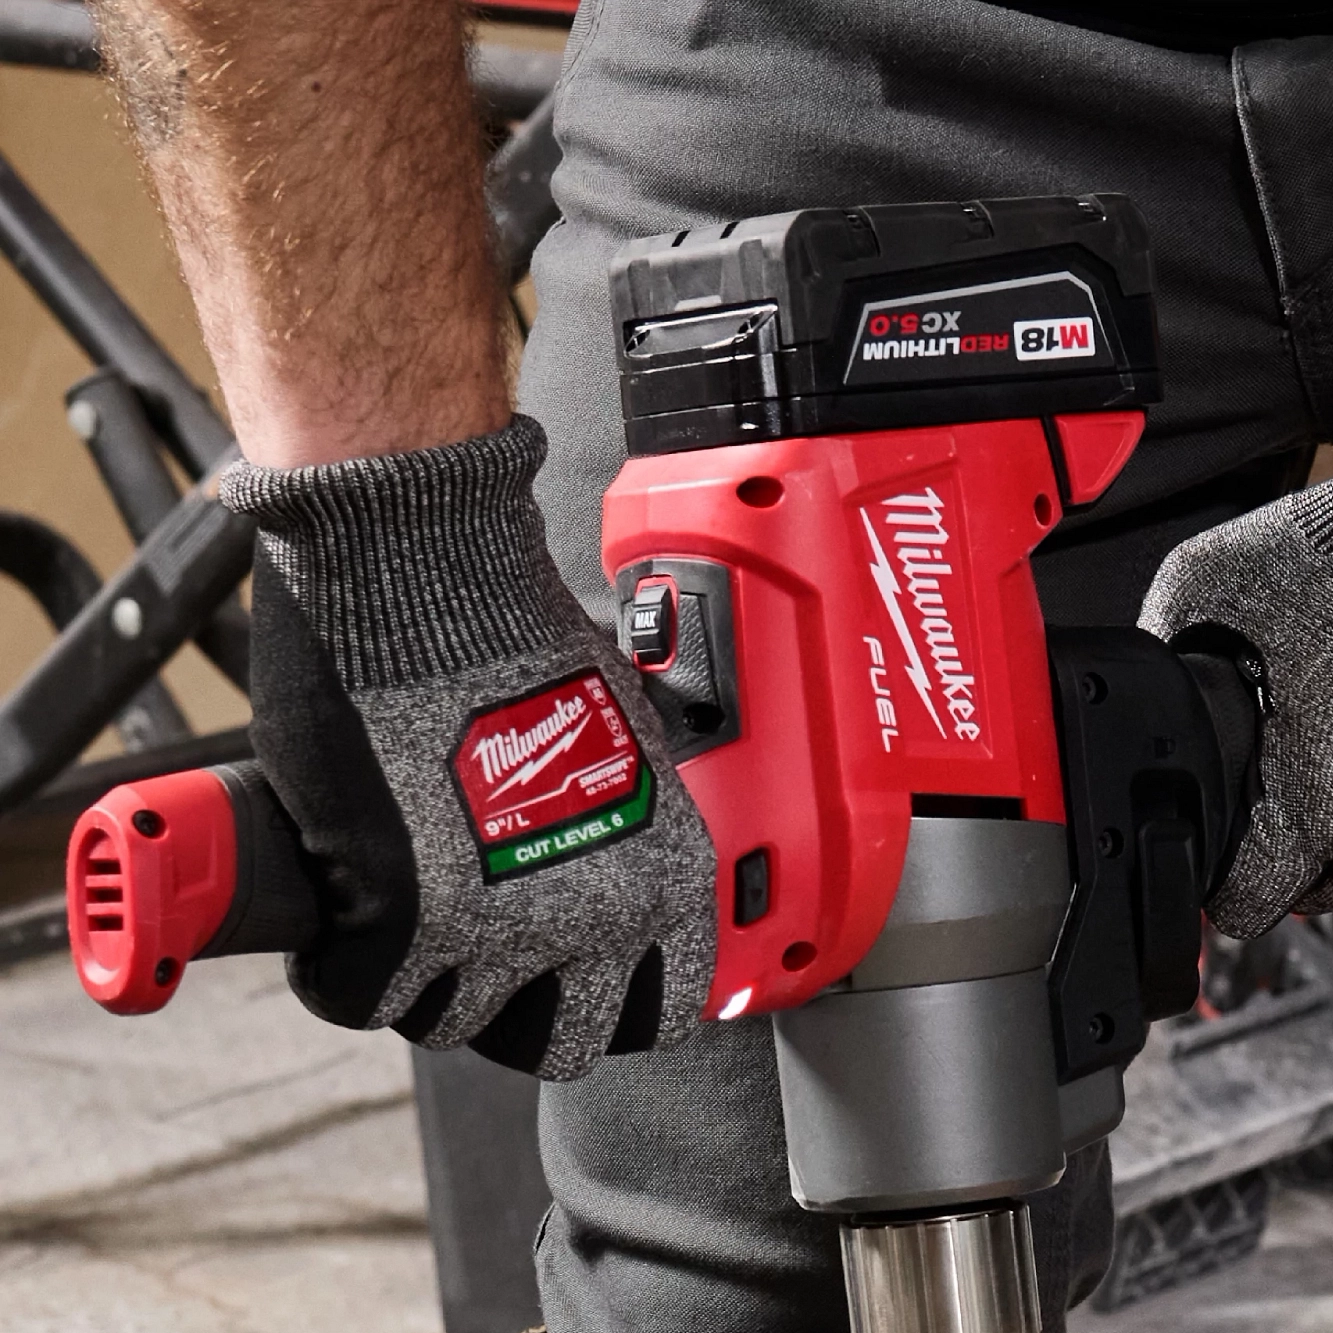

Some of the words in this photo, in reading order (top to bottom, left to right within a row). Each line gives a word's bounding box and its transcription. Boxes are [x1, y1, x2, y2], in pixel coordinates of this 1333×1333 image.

[1021, 324, 1089, 353] M18
[634, 610, 657, 629] MAX
[881, 486, 980, 741] Milwaukee
[863, 635, 899, 753] FUEL
[470, 695, 587, 784] Milwaukee
[515, 839, 551, 863] CUT
[554, 821, 611, 850] LEVEL
[611, 813, 624, 828] 6
